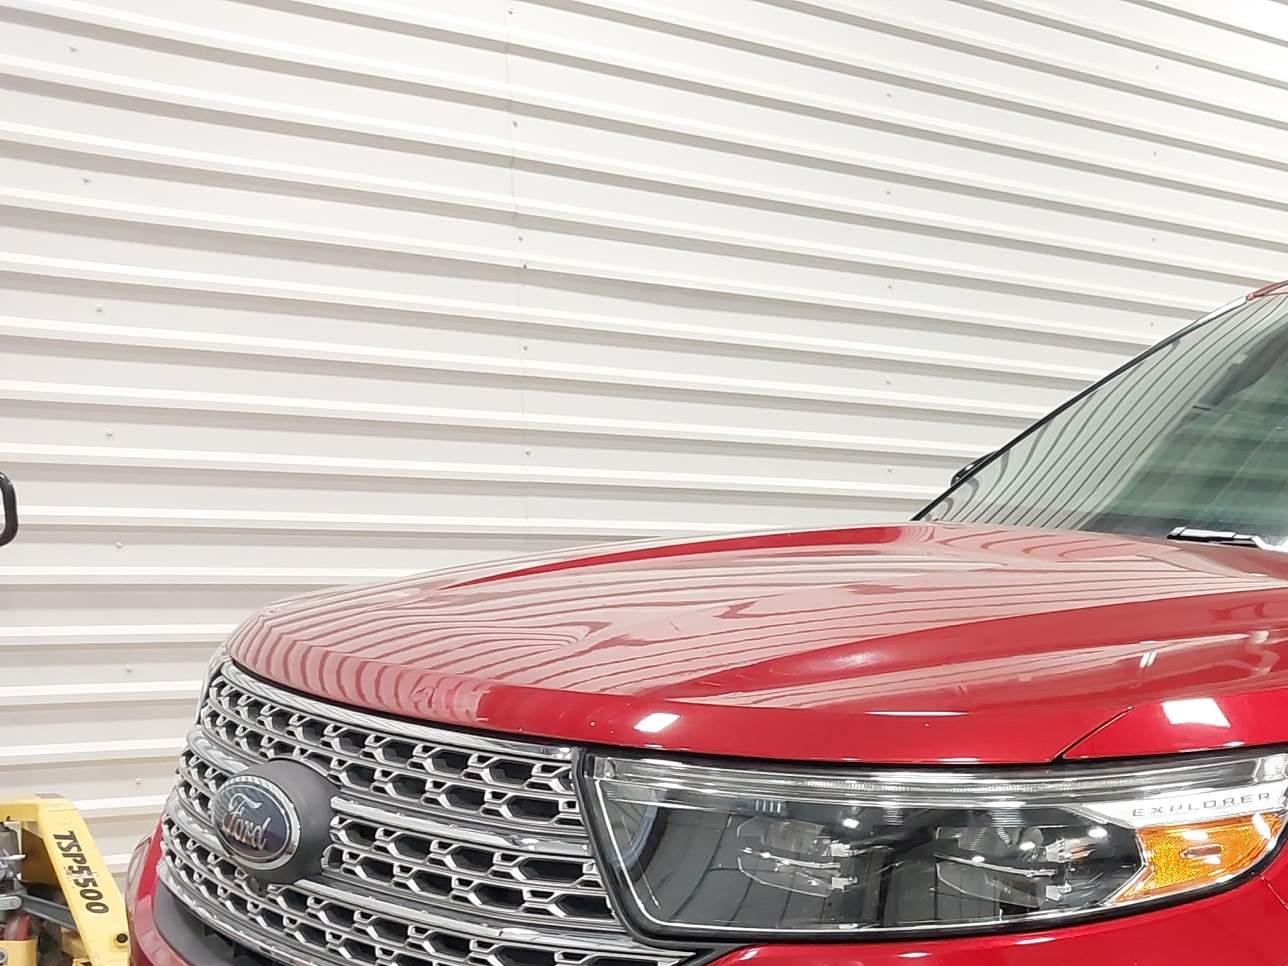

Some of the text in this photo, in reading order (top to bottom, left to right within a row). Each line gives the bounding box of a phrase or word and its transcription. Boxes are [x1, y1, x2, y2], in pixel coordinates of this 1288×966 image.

[221, 792, 272, 850] Ford
[1131, 792, 1272, 817] EXPLORER
[53, 830, 110, 914] TSP5500
